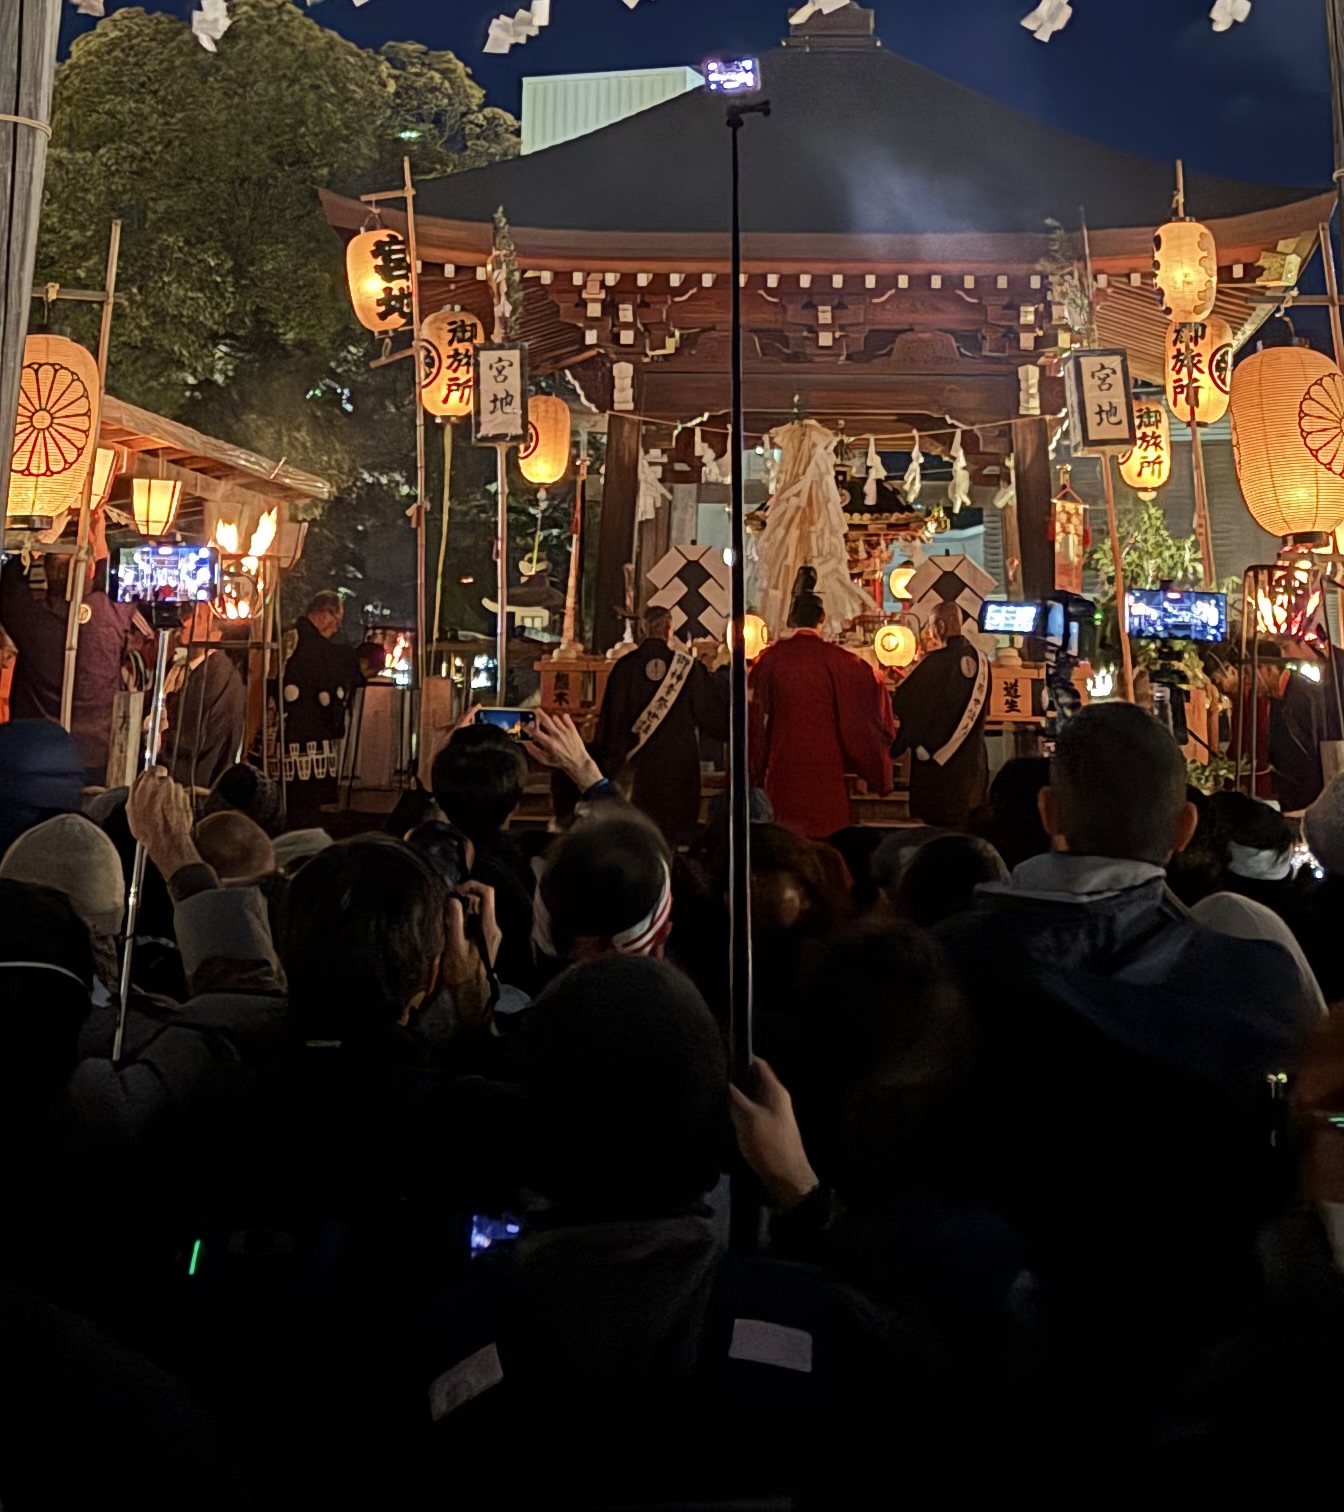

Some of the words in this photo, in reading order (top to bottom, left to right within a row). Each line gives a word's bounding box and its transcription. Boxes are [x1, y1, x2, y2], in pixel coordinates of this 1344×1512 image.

[488, 357, 518, 416] 宮地
[1090, 362, 1123, 427] 宮地
[1135, 407, 1164, 478] 御旅所
[1003, 679, 1022, 714] 道生
